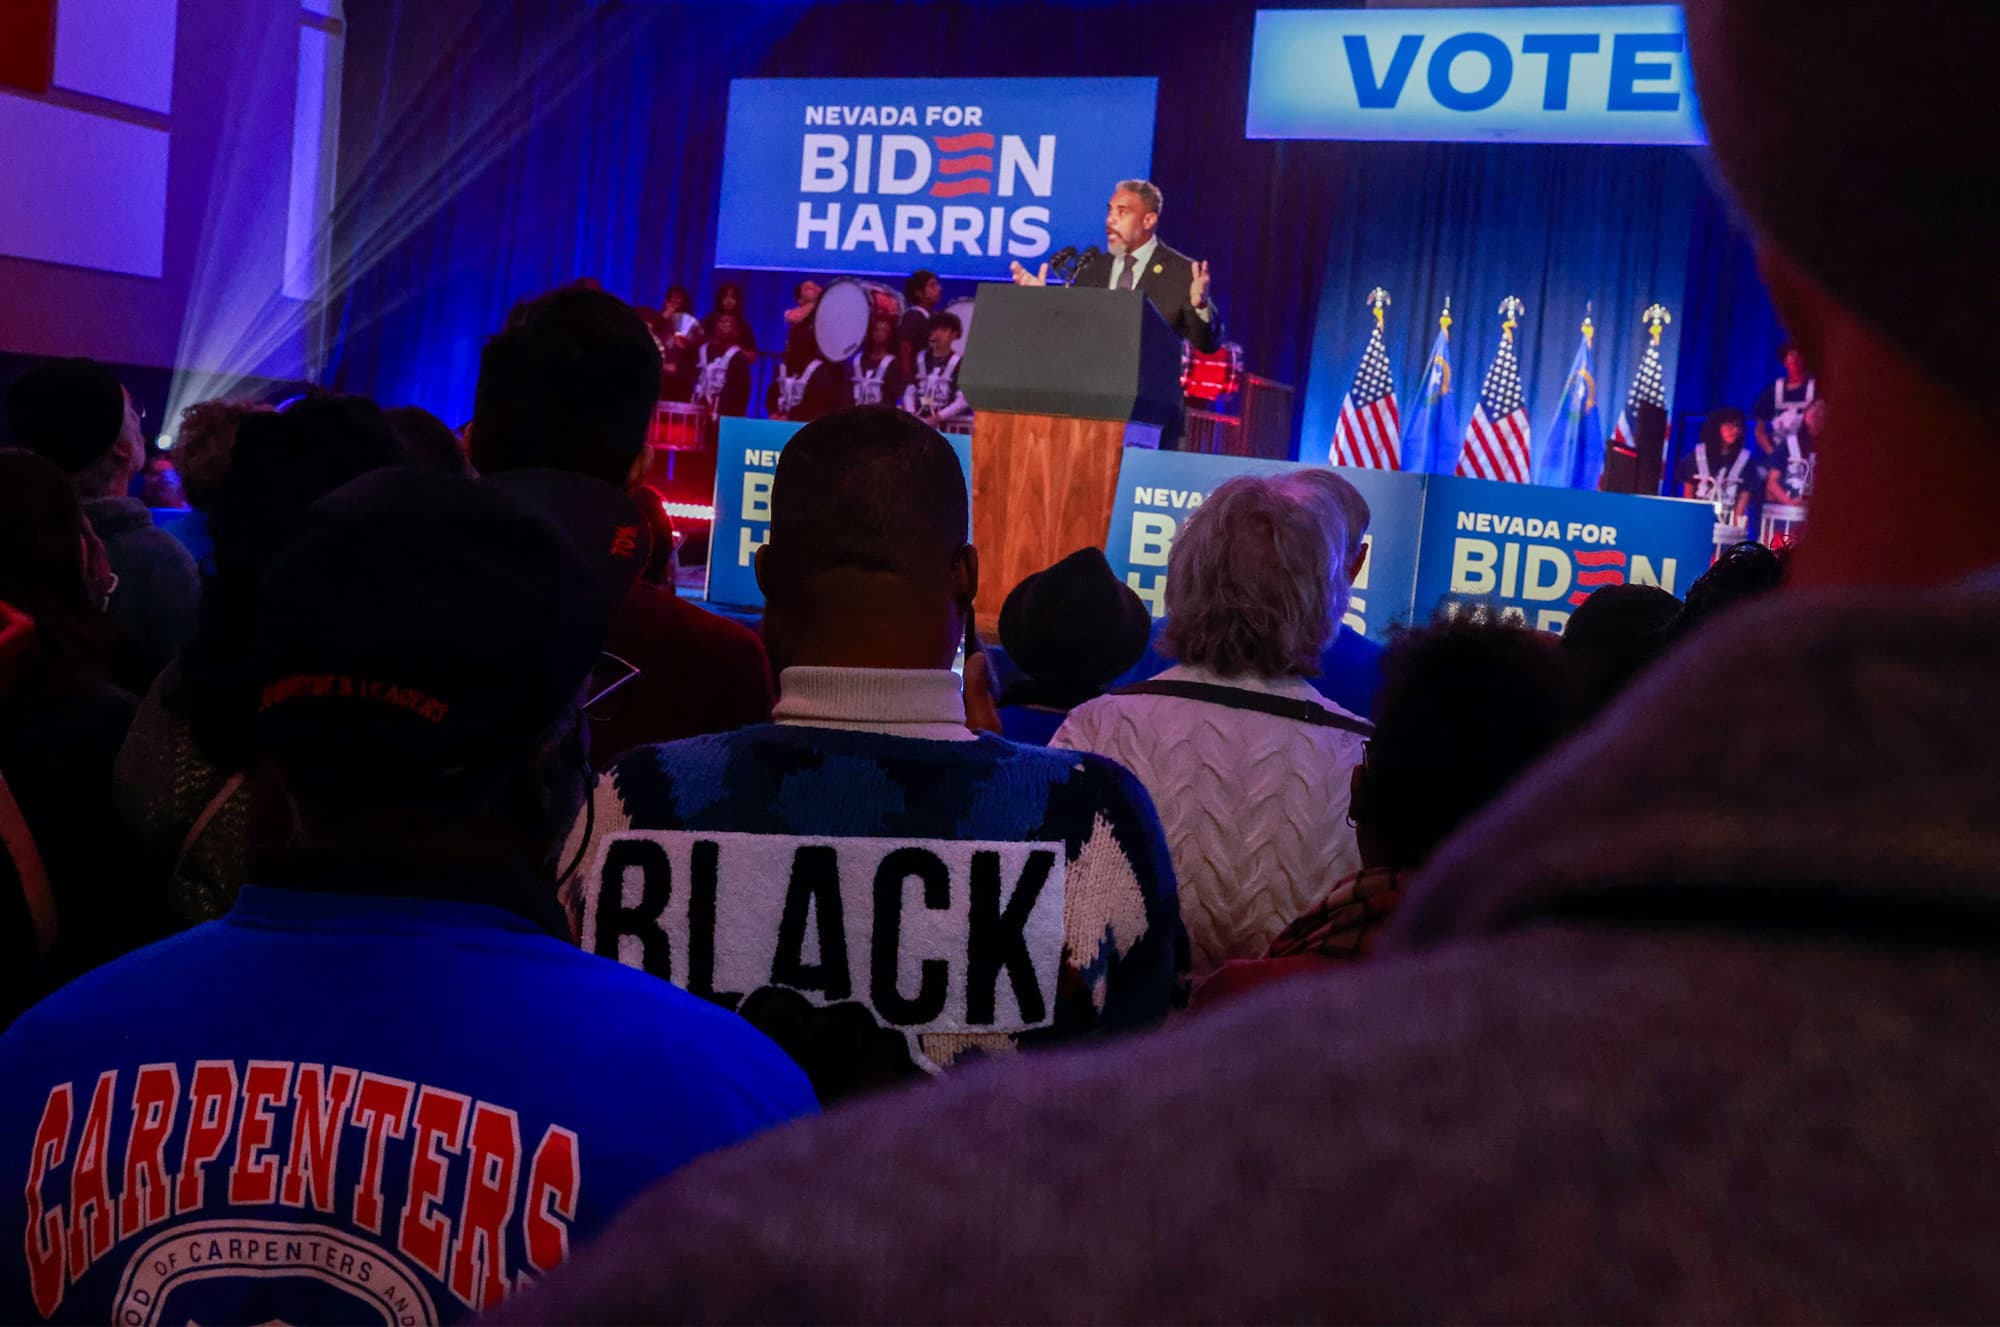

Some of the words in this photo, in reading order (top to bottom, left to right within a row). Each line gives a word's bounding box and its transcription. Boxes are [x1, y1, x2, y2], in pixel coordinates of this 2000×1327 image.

[1342, 32, 1684, 112] VOTE
[805, 105, 918, 127] NEVADA
[925, 105, 983, 127] FOR
[799, 131, 1057, 198] BIDEN
[795, 201, 1052, 258] HARRIS
[1133, 486, 1204, 510] NEVA
[1456, 511, 1561, 541] NEVADA
[1566, 522, 1618, 545] FOR
[1449, 536, 1678, 607] BIDEN
[597, 839, 1056, 1027] BLACK
[24, 1058, 582, 1321] CARPENTERS
[154, 1253, 177, 1277] OF
[189, 1238, 374, 1282] CARPENTERS
[383, 1285, 417, 1327] AND
